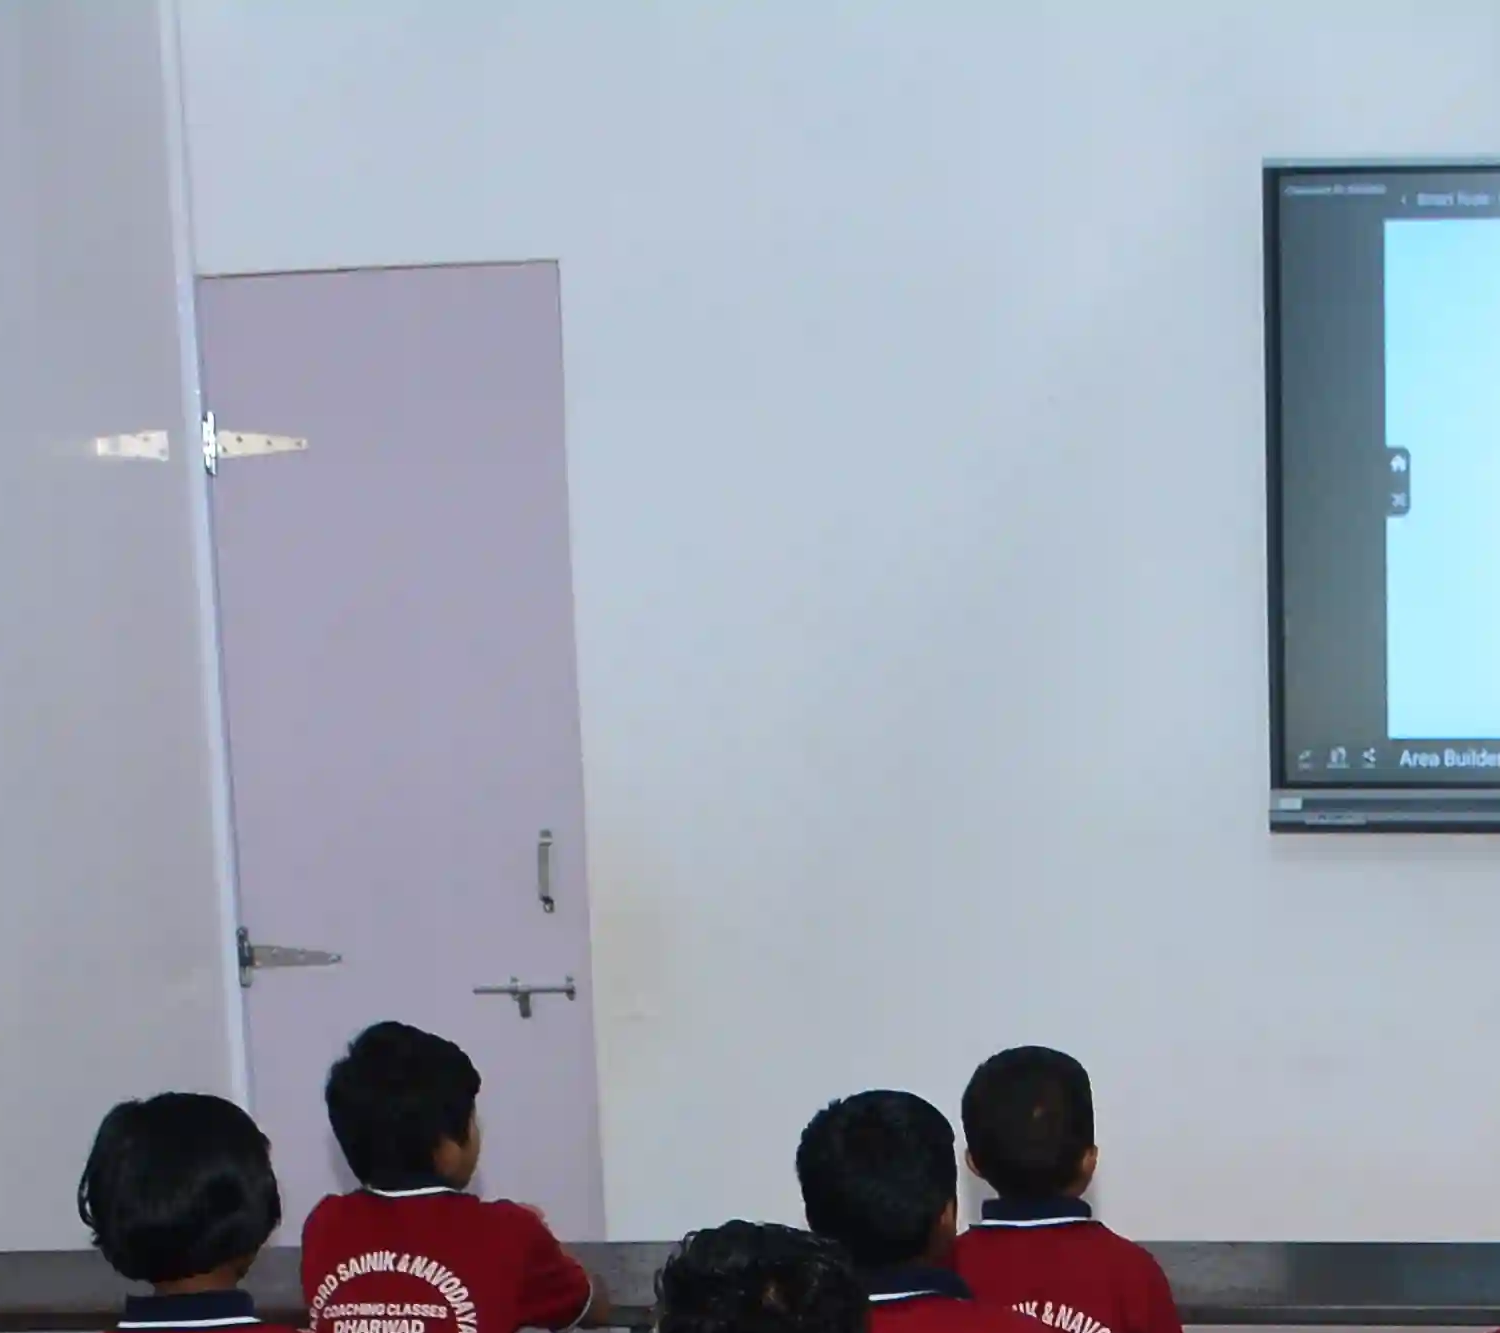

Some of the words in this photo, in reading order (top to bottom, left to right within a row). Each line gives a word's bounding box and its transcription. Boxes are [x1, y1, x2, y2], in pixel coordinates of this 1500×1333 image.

[1400, 749, 1440, 768] Area
[337, 1250, 397, 1282] SAINIK
[396, 1254, 410, 1273] &
[323, 1303, 385, 1319] COACHING
[386, 1303, 447, 1318] CLASSES
[1041, 1301, 1054, 1326] &
